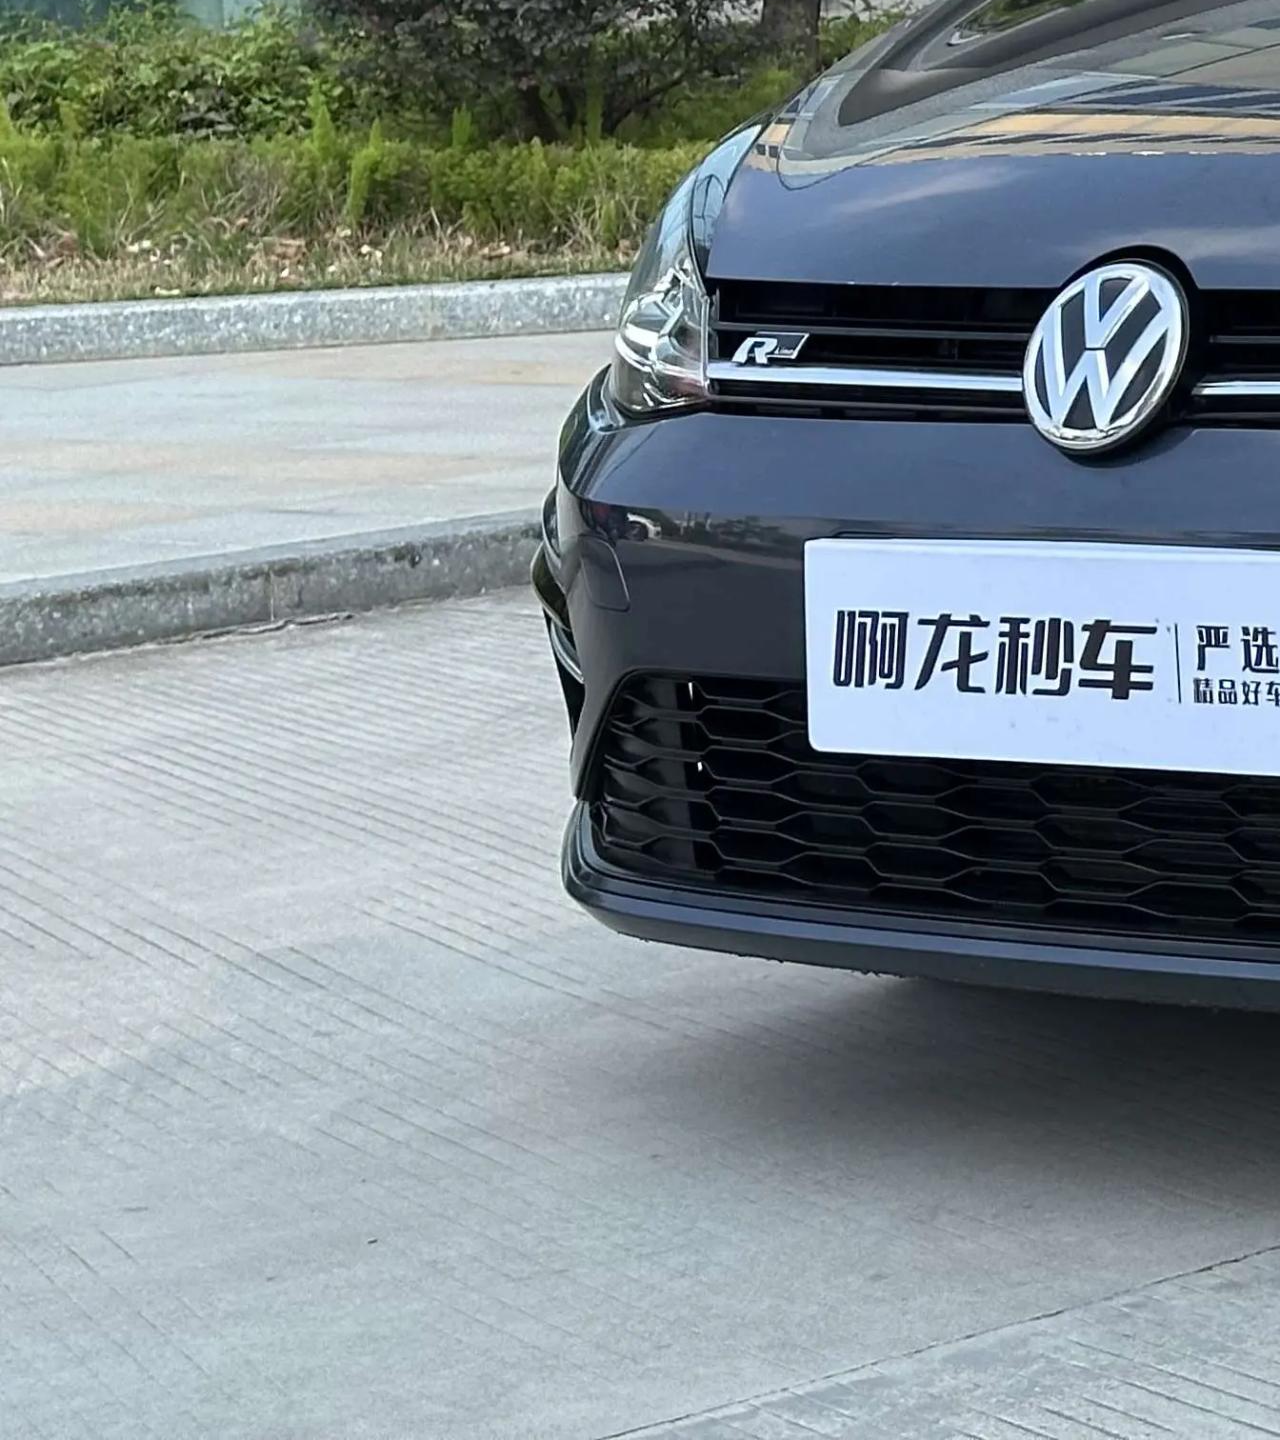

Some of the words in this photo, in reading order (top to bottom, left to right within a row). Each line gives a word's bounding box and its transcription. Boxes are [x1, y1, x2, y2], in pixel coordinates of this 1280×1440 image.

[833, 609, 1158, 700] 啊龙秒车
[1196, 624, 1280, 674] 严选
